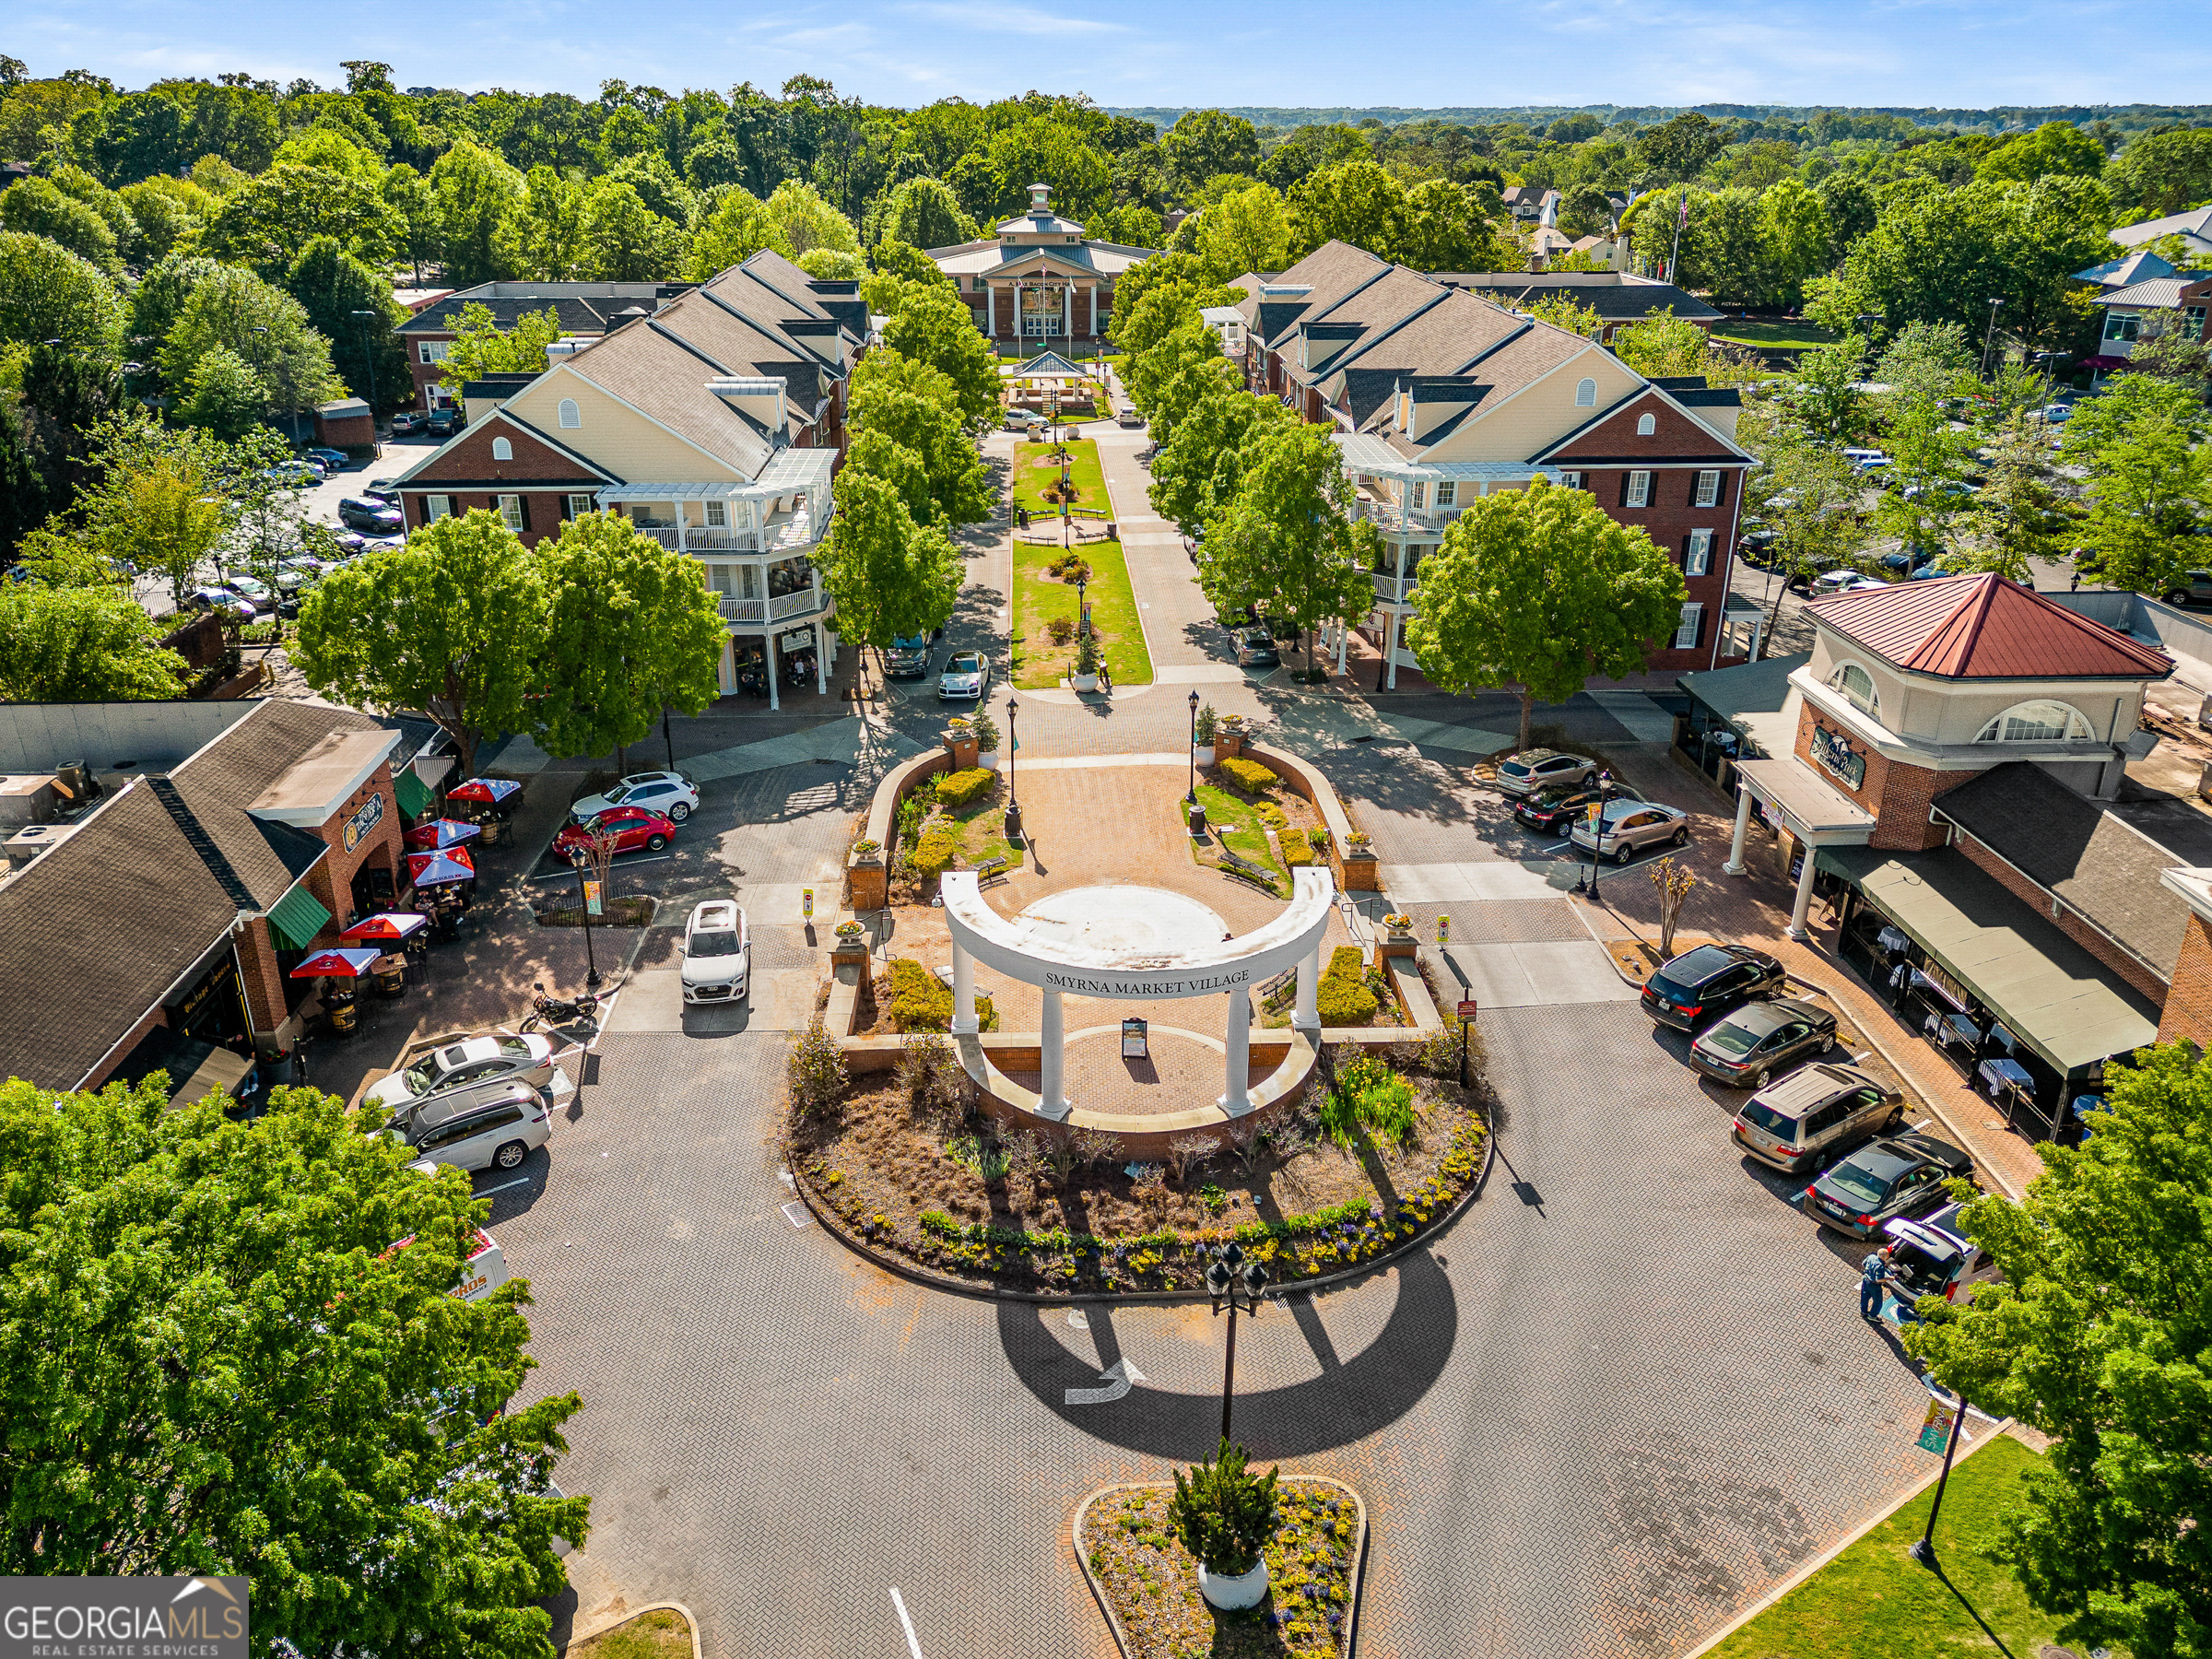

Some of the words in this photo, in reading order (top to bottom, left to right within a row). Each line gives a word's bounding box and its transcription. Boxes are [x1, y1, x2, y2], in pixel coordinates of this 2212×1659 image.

[1841, 756, 1858, 775] Park
[1046, 972, 1111, 994] SMYRNA
[1114, 982, 1184, 994] MARKET
[1188, 970, 1250, 991] VILLAGE
[1925, 1407, 1947, 1449] SMYRNA
